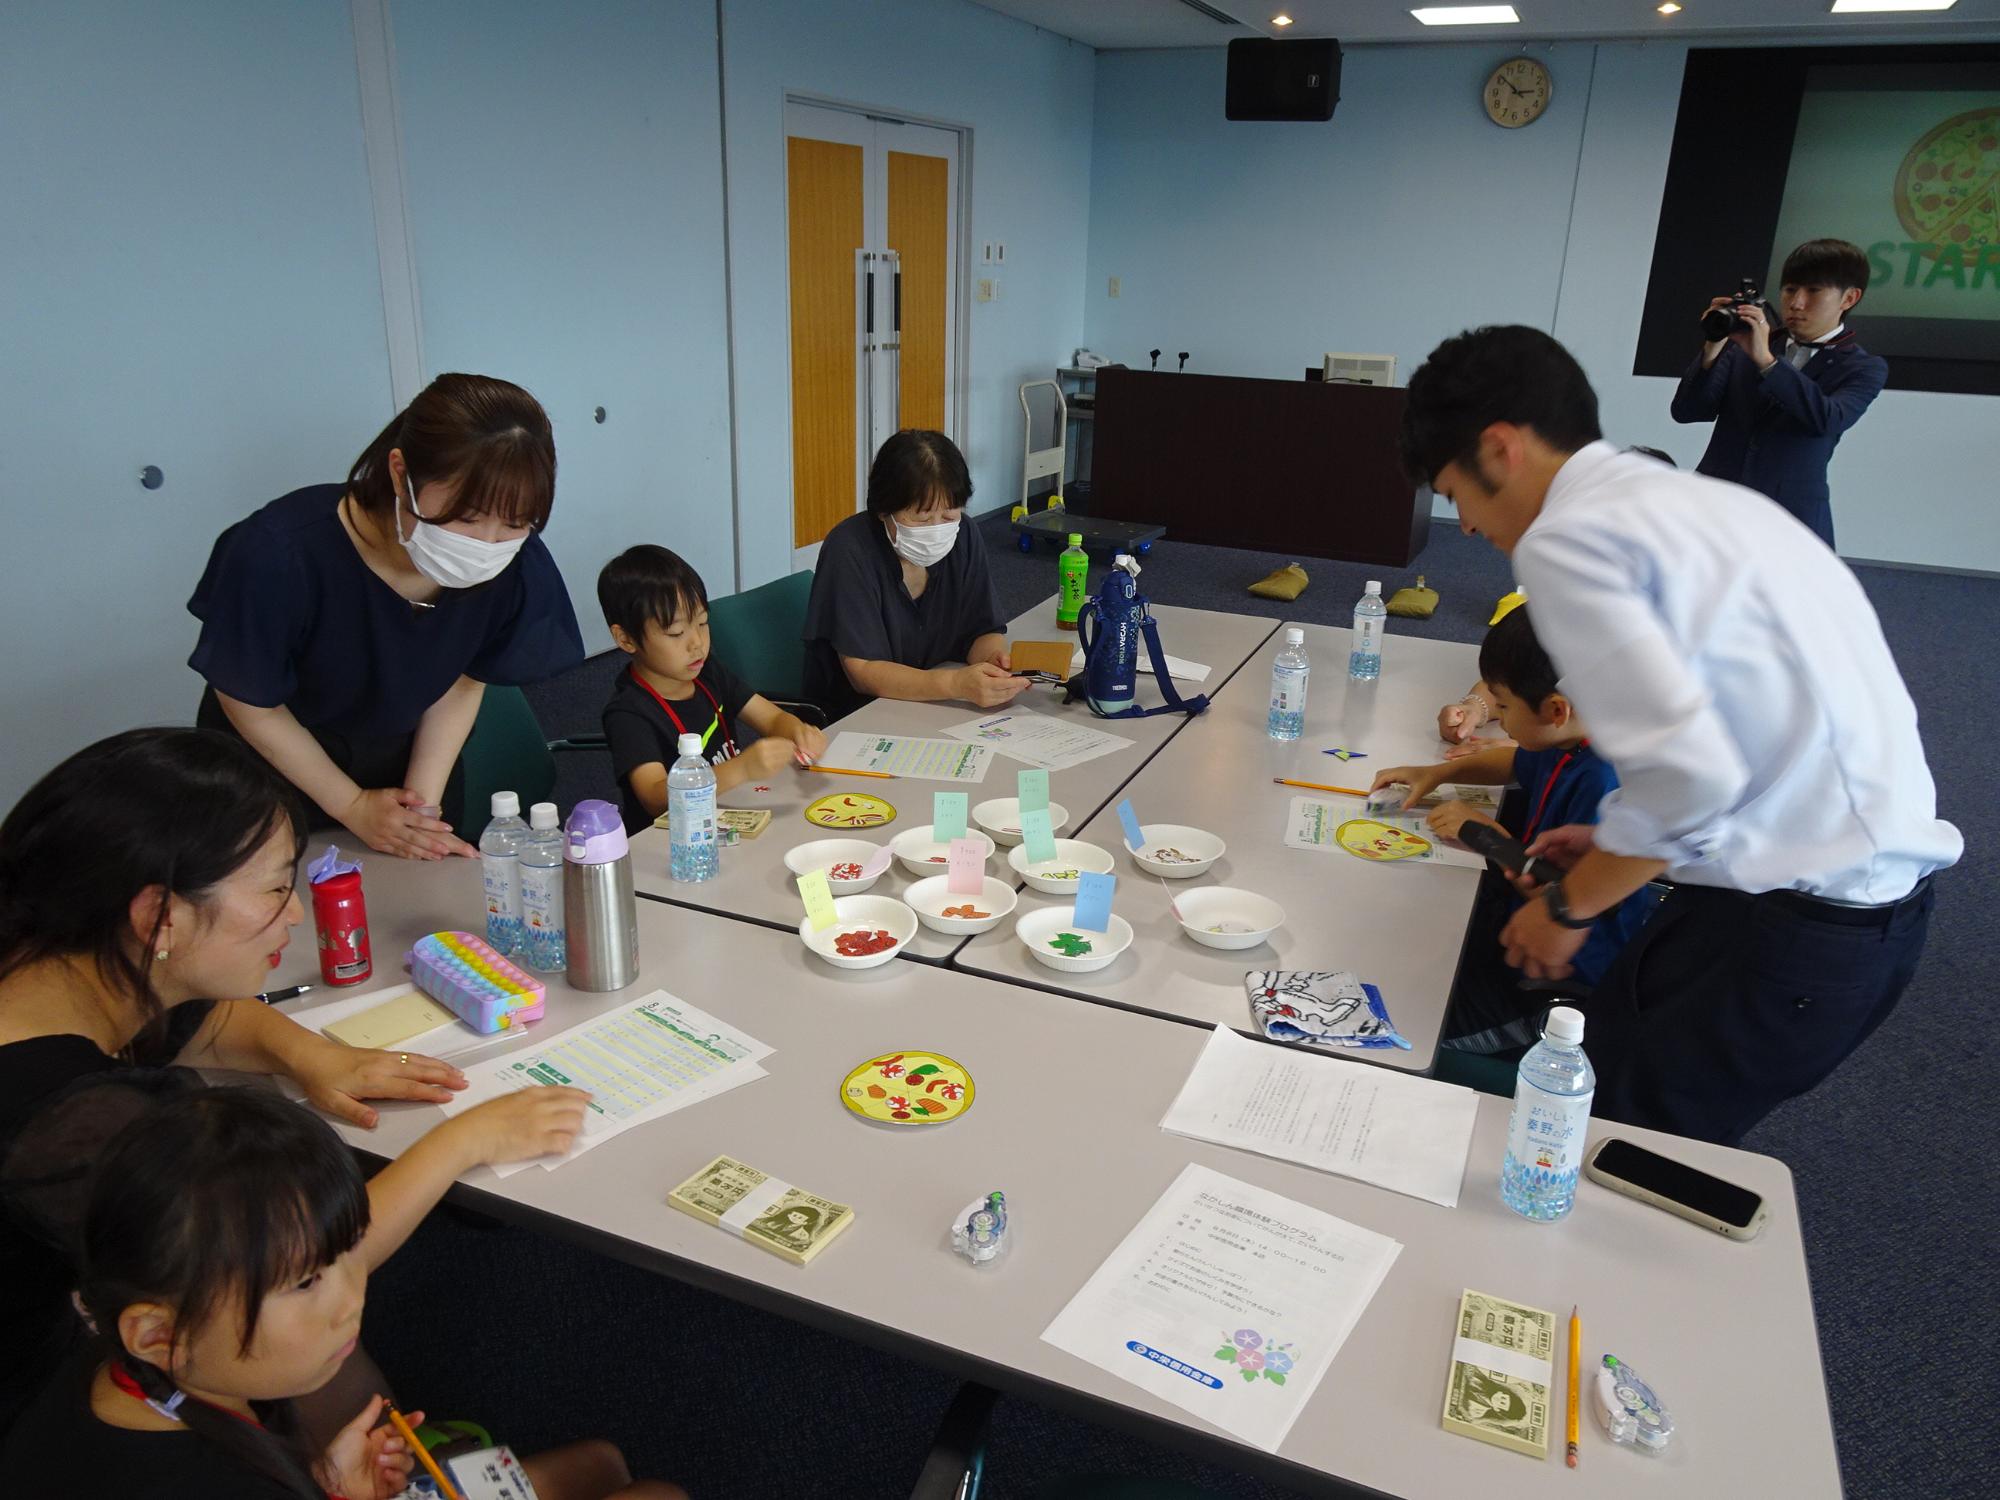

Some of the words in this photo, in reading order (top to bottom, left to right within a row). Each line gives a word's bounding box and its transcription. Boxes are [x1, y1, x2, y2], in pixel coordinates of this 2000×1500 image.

[1118, 622, 1127, 665] HYDRATION
[1530, 1106, 1575, 1123] おいしい
